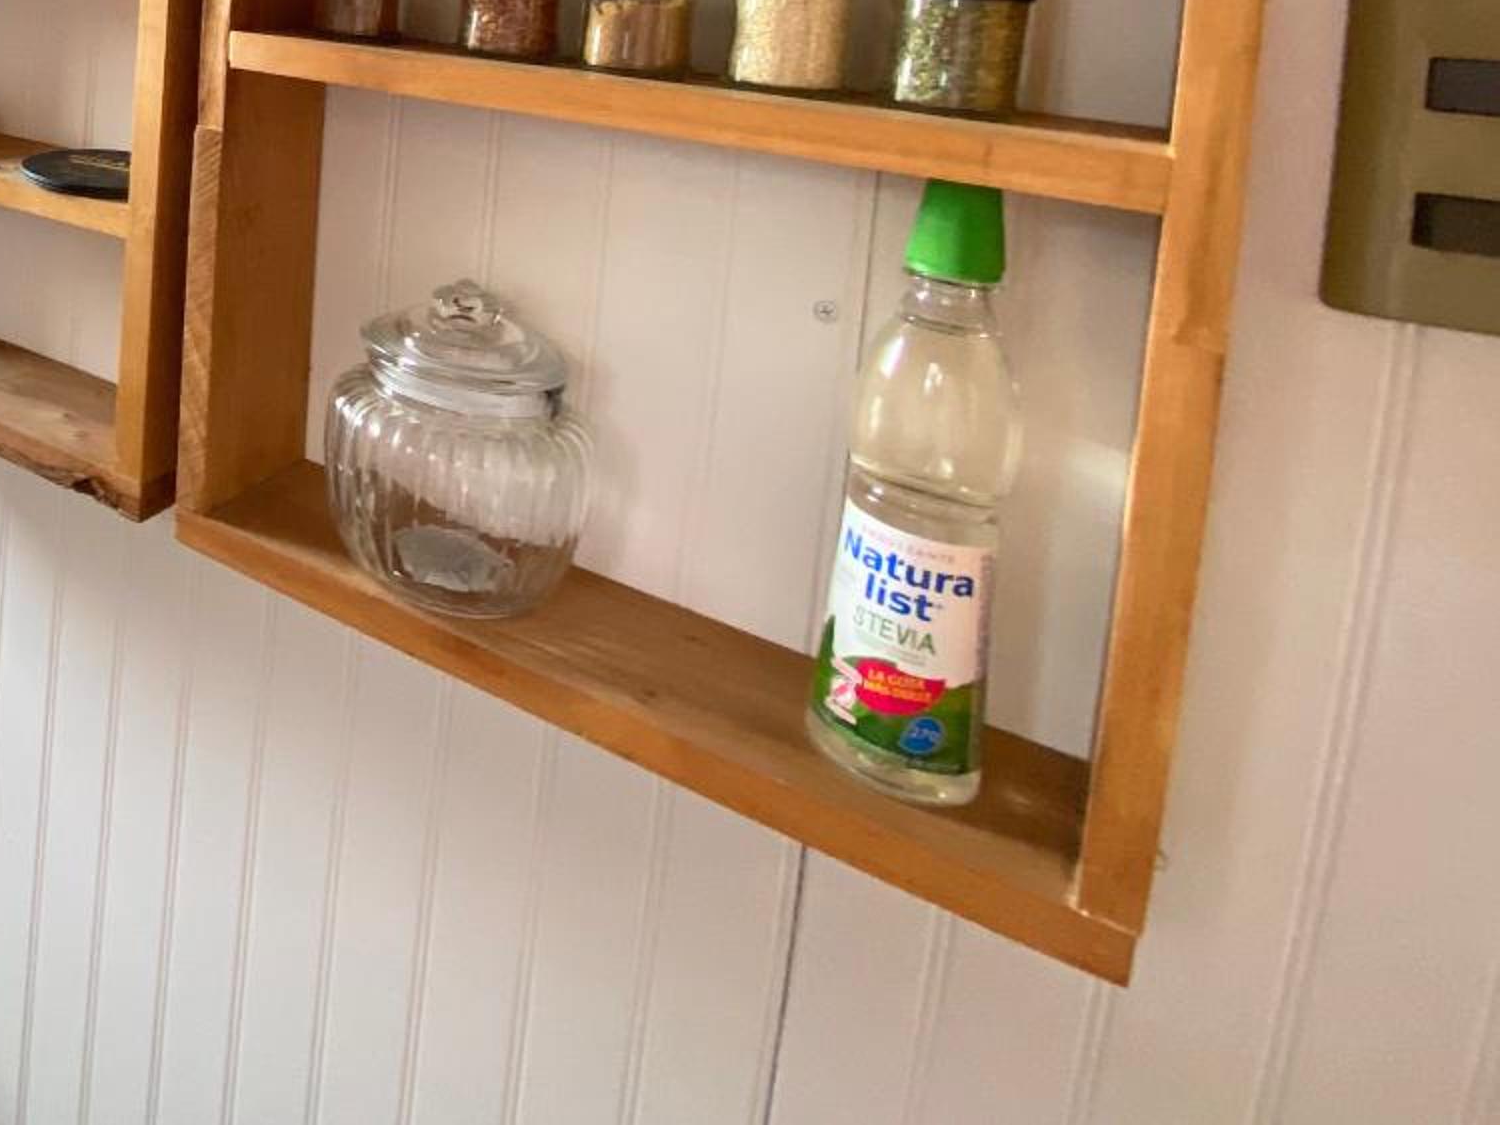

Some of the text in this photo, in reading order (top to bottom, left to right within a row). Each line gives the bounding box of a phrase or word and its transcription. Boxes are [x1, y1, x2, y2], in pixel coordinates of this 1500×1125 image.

[844, 528, 975, 598] Natura
[864, 572, 934, 623] list
[853, 605, 937, 655] STEVIA
